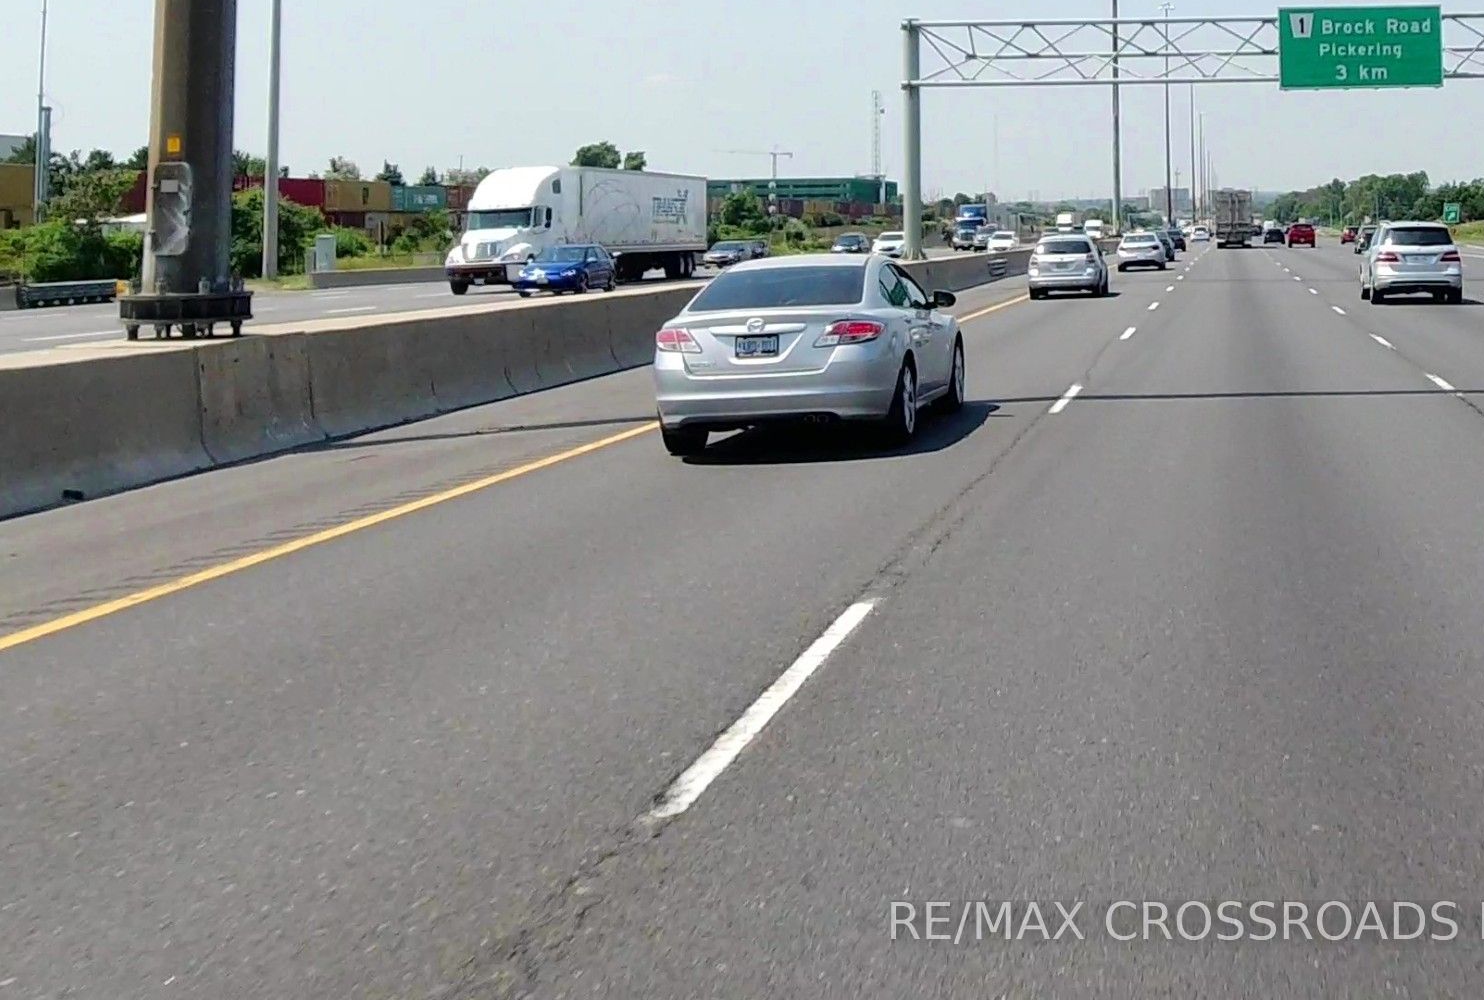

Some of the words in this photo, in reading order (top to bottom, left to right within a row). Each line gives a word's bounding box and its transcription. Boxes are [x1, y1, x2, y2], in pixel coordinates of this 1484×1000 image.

[1298, 16, 1305, 34] 1
[1321, 18, 1375, 35] Brock
[1386, 17, 1432, 34] Road
[1319, 42, 1403, 59] Pickering
[1335, 64, 1348, 81] 3
[1359, 64, 1388, 81] km
